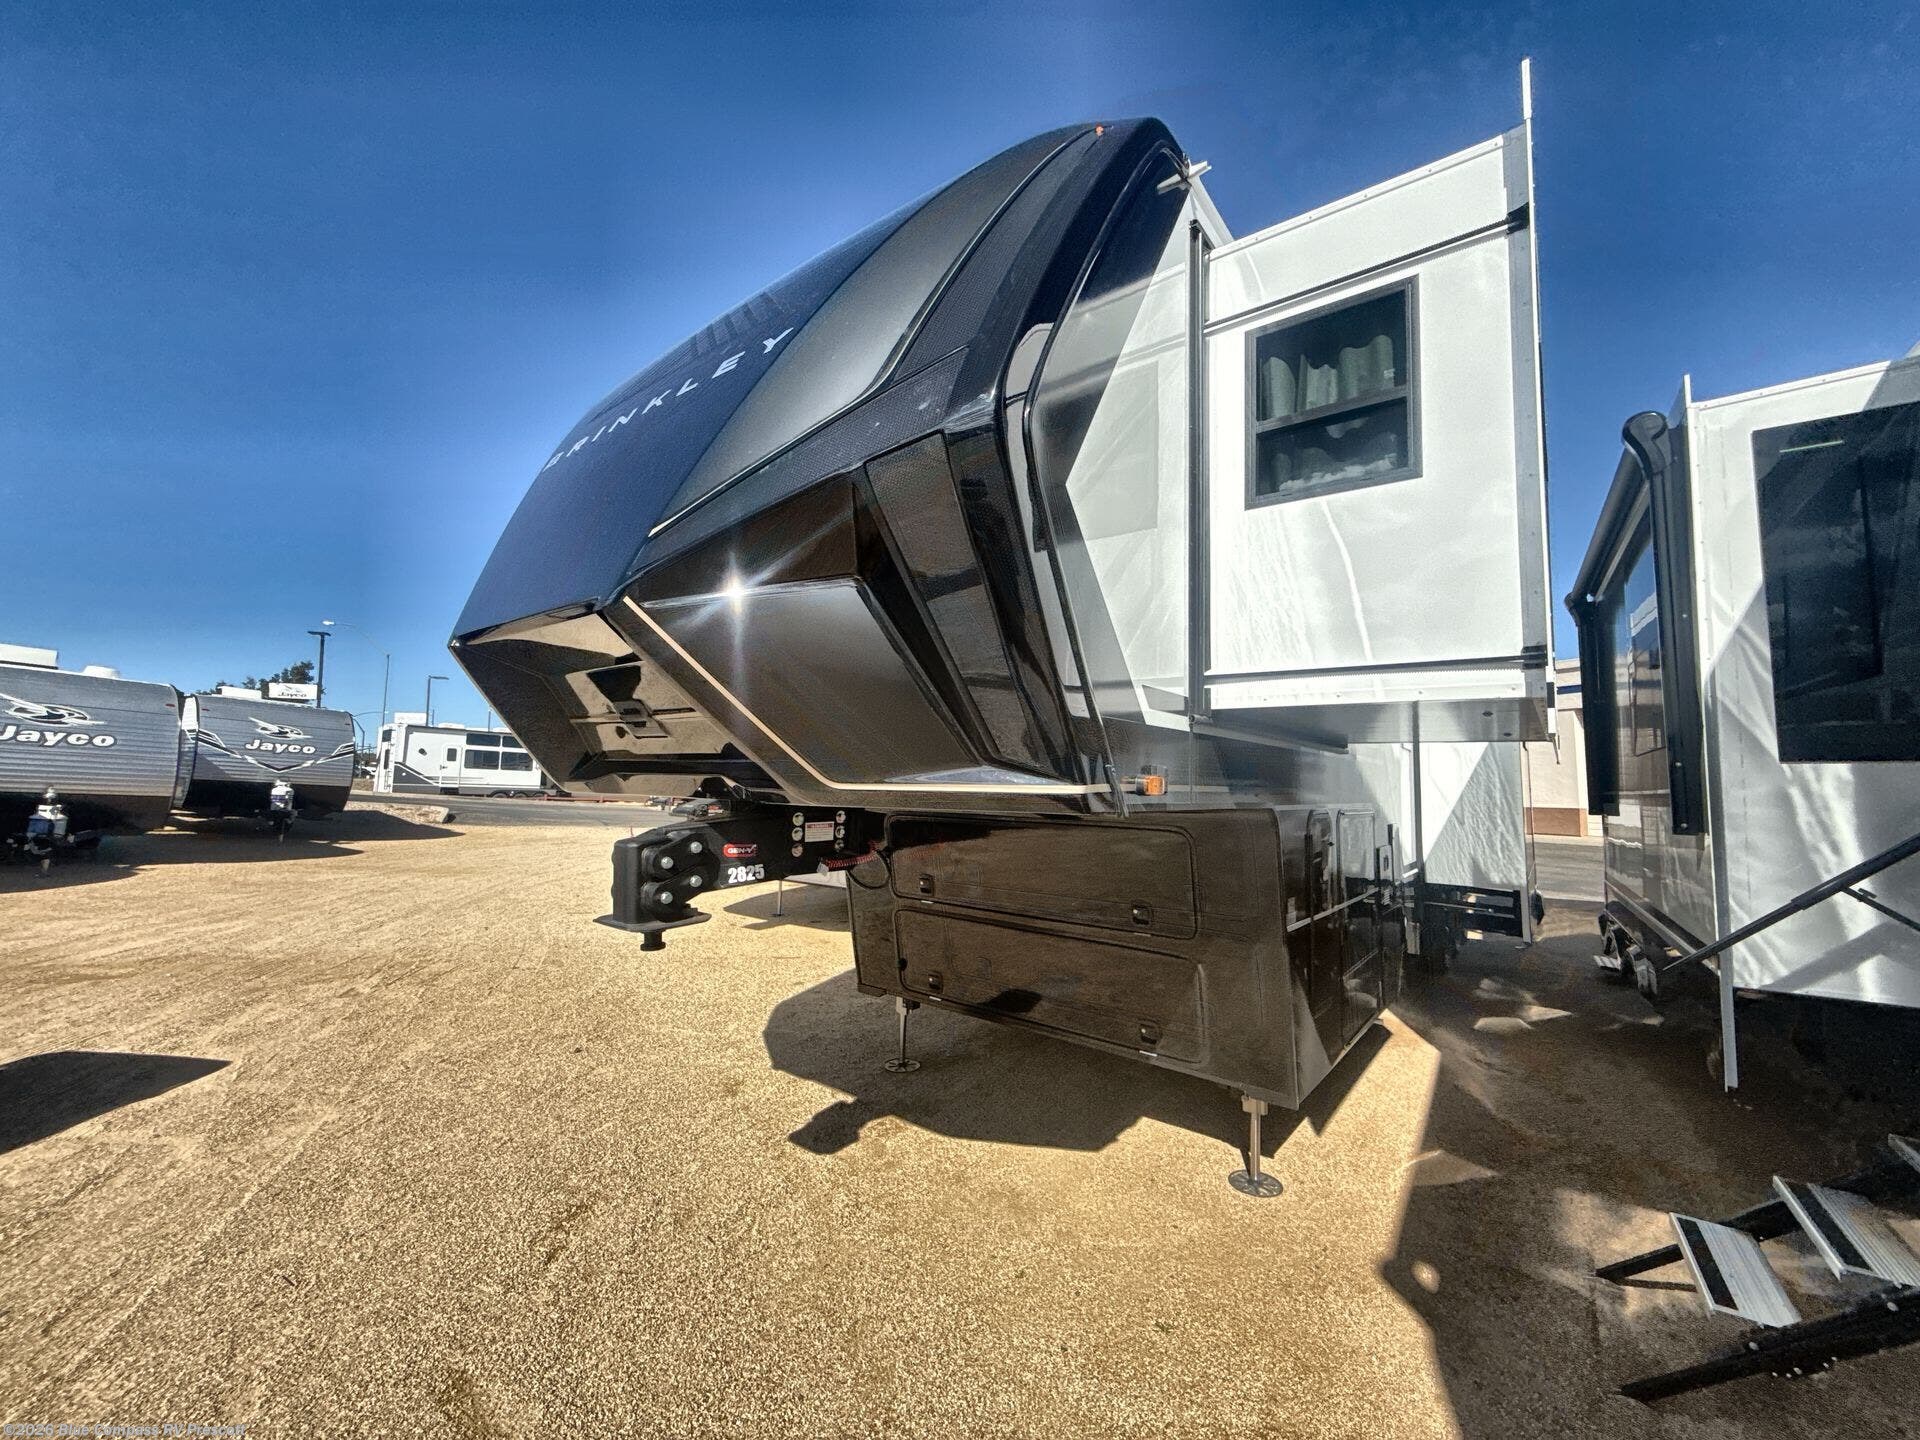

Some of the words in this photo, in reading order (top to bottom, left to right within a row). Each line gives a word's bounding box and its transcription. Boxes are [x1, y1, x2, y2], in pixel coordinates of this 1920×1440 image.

[0, 725, 115, 747] Jayco
[245, 739, 316, 754] Jayco
[727, 863, 765, 884] 2825
